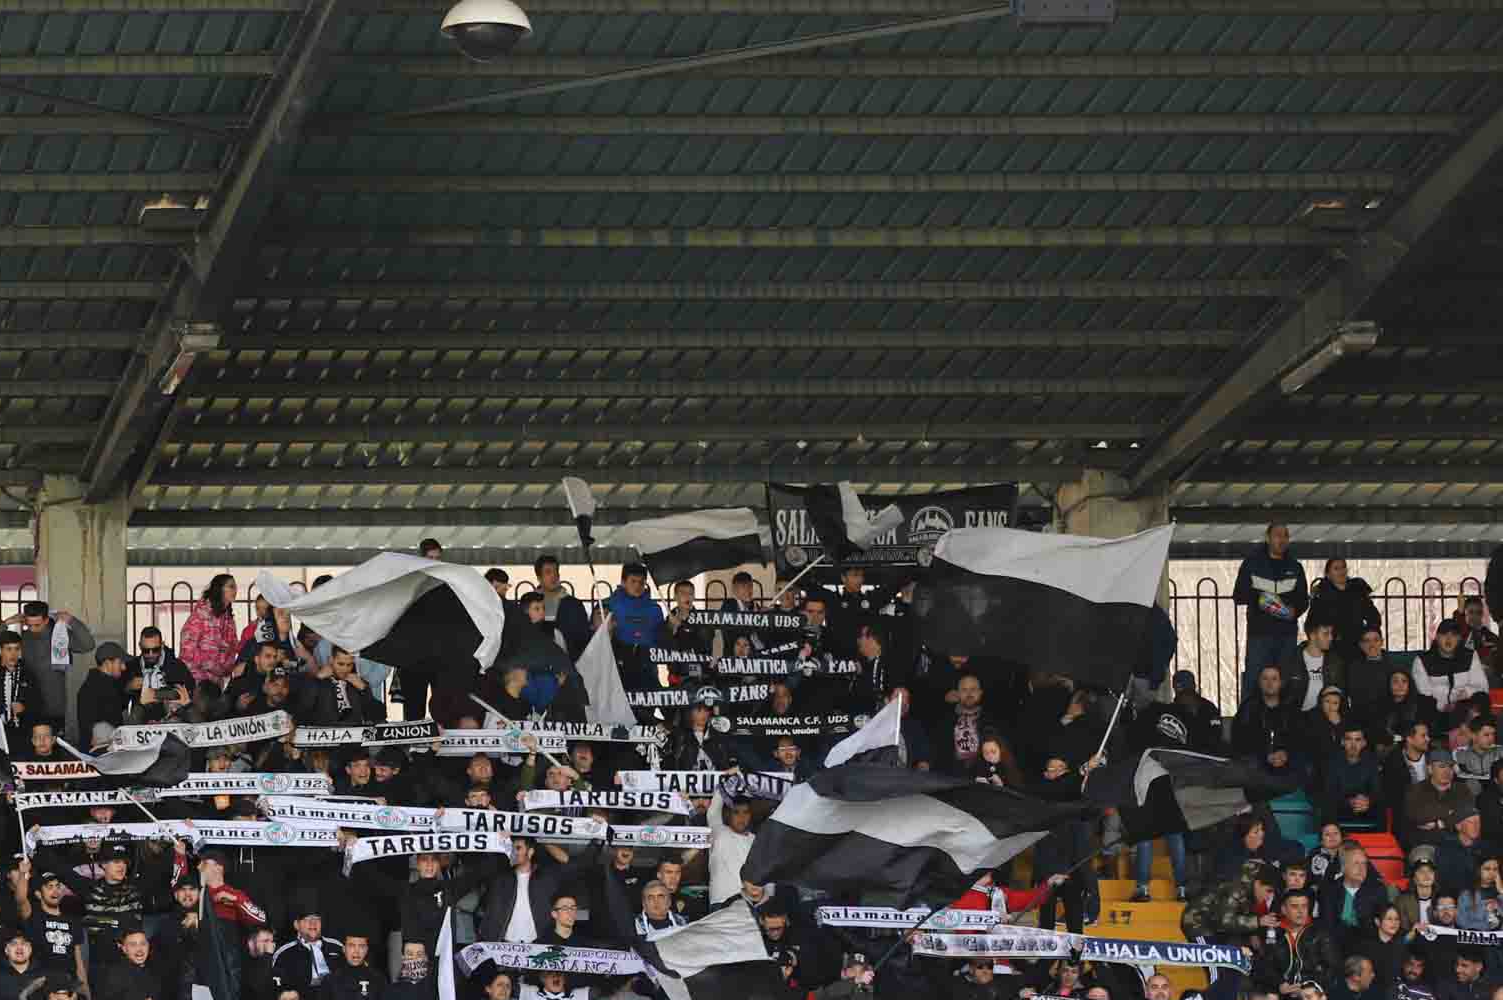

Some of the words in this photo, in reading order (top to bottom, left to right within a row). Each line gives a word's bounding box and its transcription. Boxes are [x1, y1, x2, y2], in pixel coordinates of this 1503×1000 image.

[688, 612, 769, 628] SALAMANCA
[775, 616, 800, 628] UDS
[628, 690, 689, 707] LMANTICA
[206, 726, 222, 740] LA
[228, 718, 266, 738] UNIÓN
[736, 717, 800, 726] SALAMANCA
[828, 715, 849, 724] UDS
[307, 730, 352, 742] HALA
[17, 791, 128, 808] SALAMANCA
[558, 790, 672, 808] TARUSOS
[462, 811, 573, 835] TARUSOS
[368, 835, 488, 855] TARUSOS
